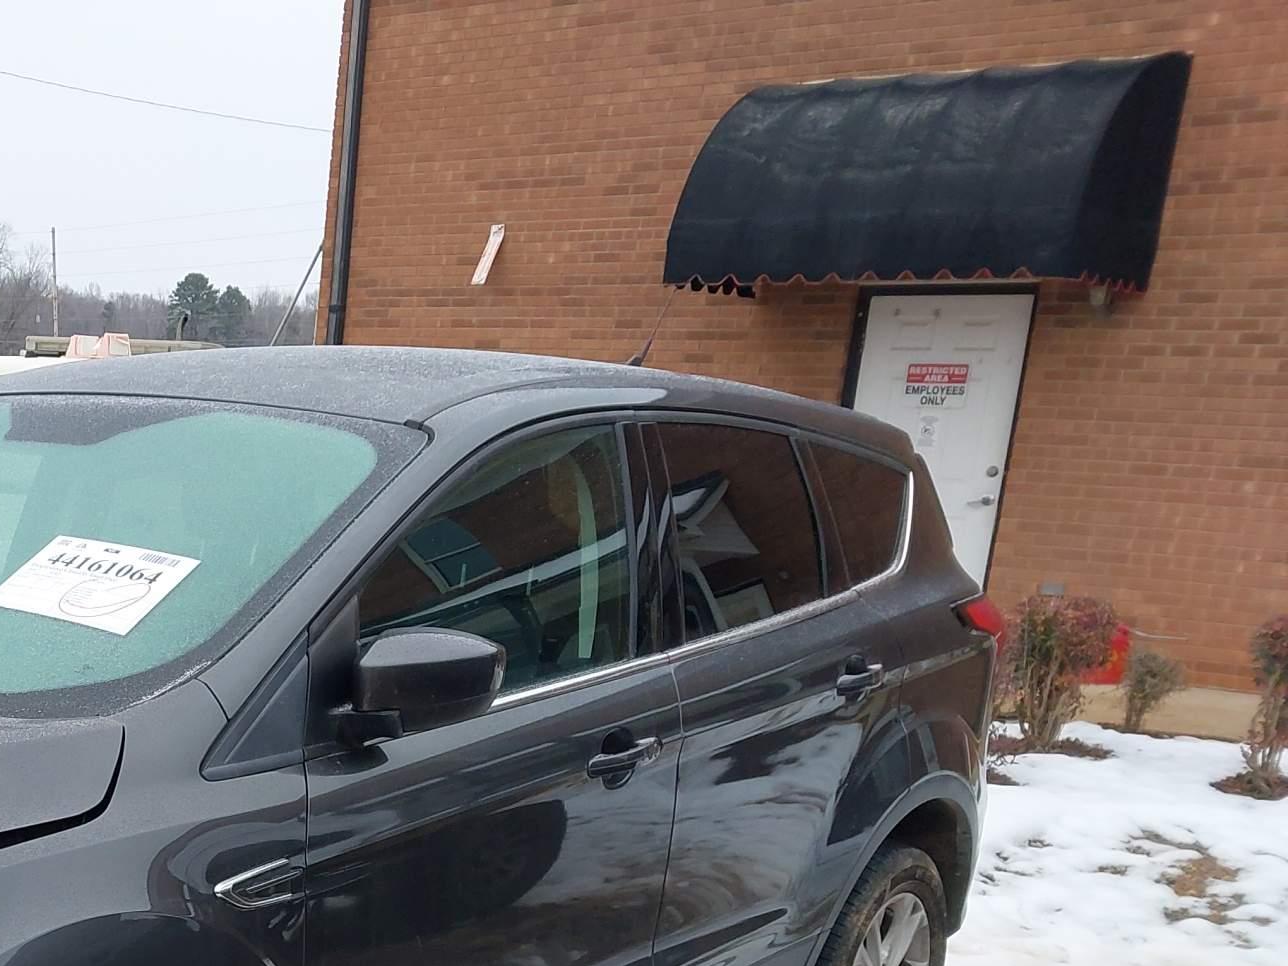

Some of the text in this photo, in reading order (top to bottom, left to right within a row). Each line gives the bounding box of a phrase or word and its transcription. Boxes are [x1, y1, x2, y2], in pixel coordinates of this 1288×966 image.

[909, 366, 967, 374] RESTRICTED
[923, 374, 949, 382] AREA
[905, 385, 965, 395] EMPLOYEES
[920, 396, 946, 406] ONLY
[48, 552, 163, 584] 44161064
